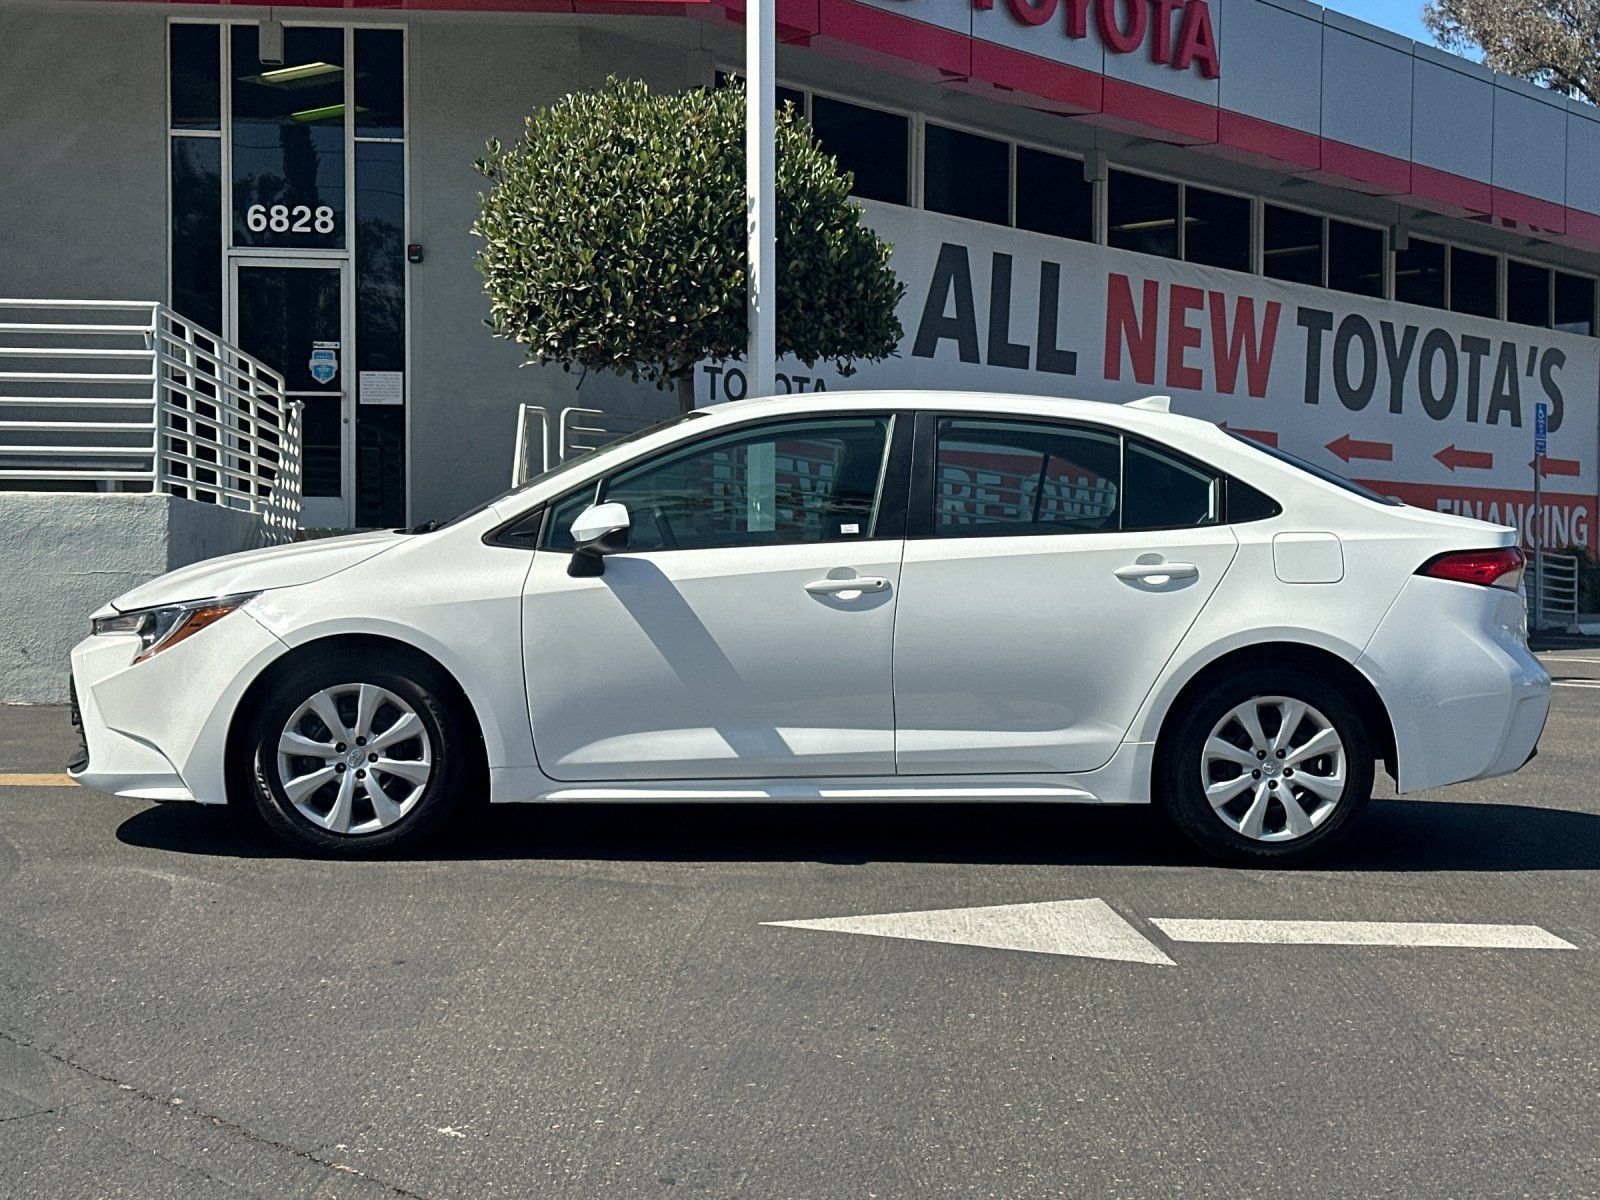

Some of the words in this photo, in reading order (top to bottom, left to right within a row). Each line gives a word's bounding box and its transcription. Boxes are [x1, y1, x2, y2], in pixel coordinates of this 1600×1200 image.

[247, 204, 335, 234] 6828
[911, 242, 1077, 376] ALL
[1104, 272, 1282, 398] NEW
[1297, 306, 1566, 433] TOYOTA'S
